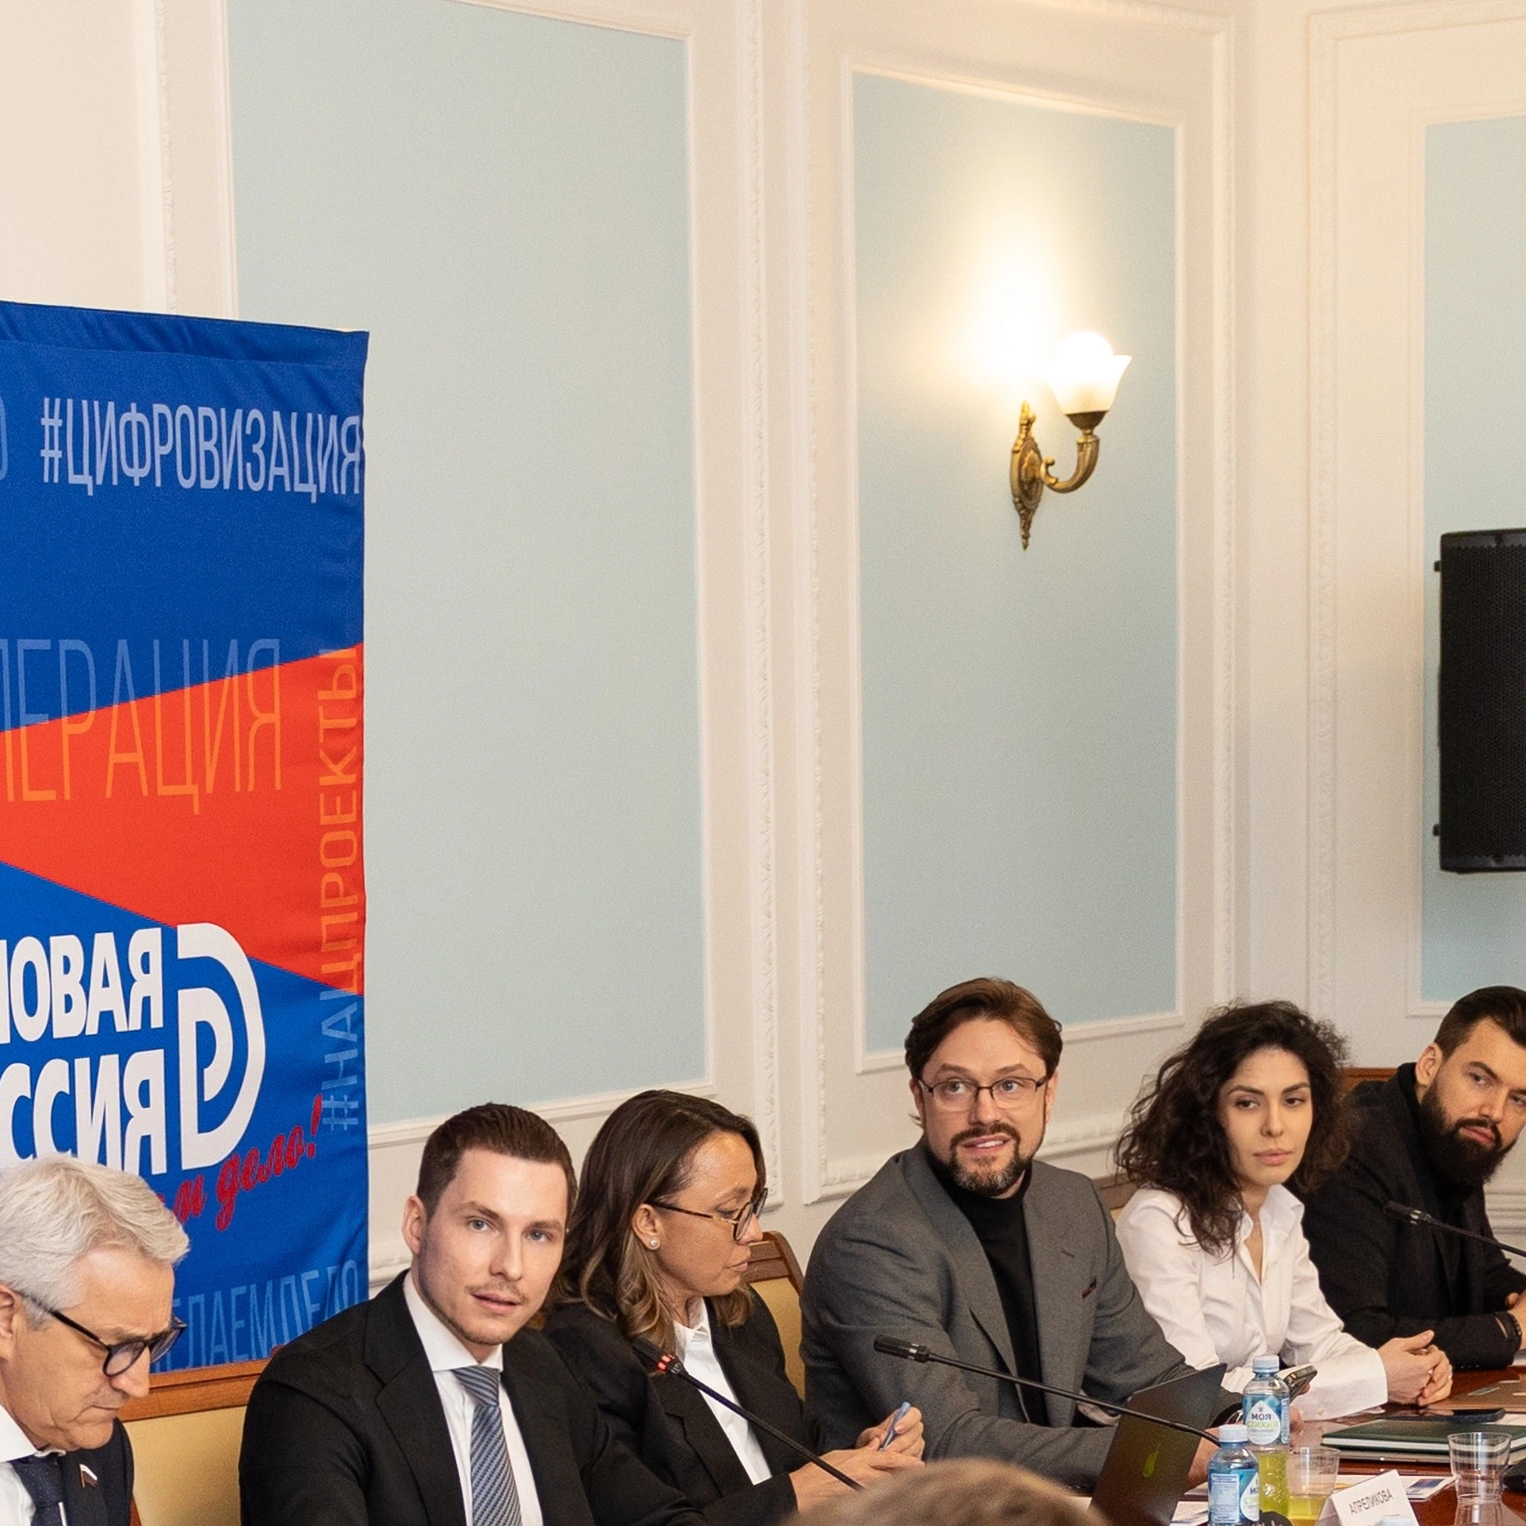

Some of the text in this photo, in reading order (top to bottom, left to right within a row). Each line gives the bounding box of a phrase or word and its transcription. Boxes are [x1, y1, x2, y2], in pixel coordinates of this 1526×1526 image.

[40, 396, 363, 503] #ЦИФРОВИЗАЦИЯ
[318, 648, 360, 1131] #НАЦПРОЕКТЫ
[215, 1093, 323, 1232] дело!
